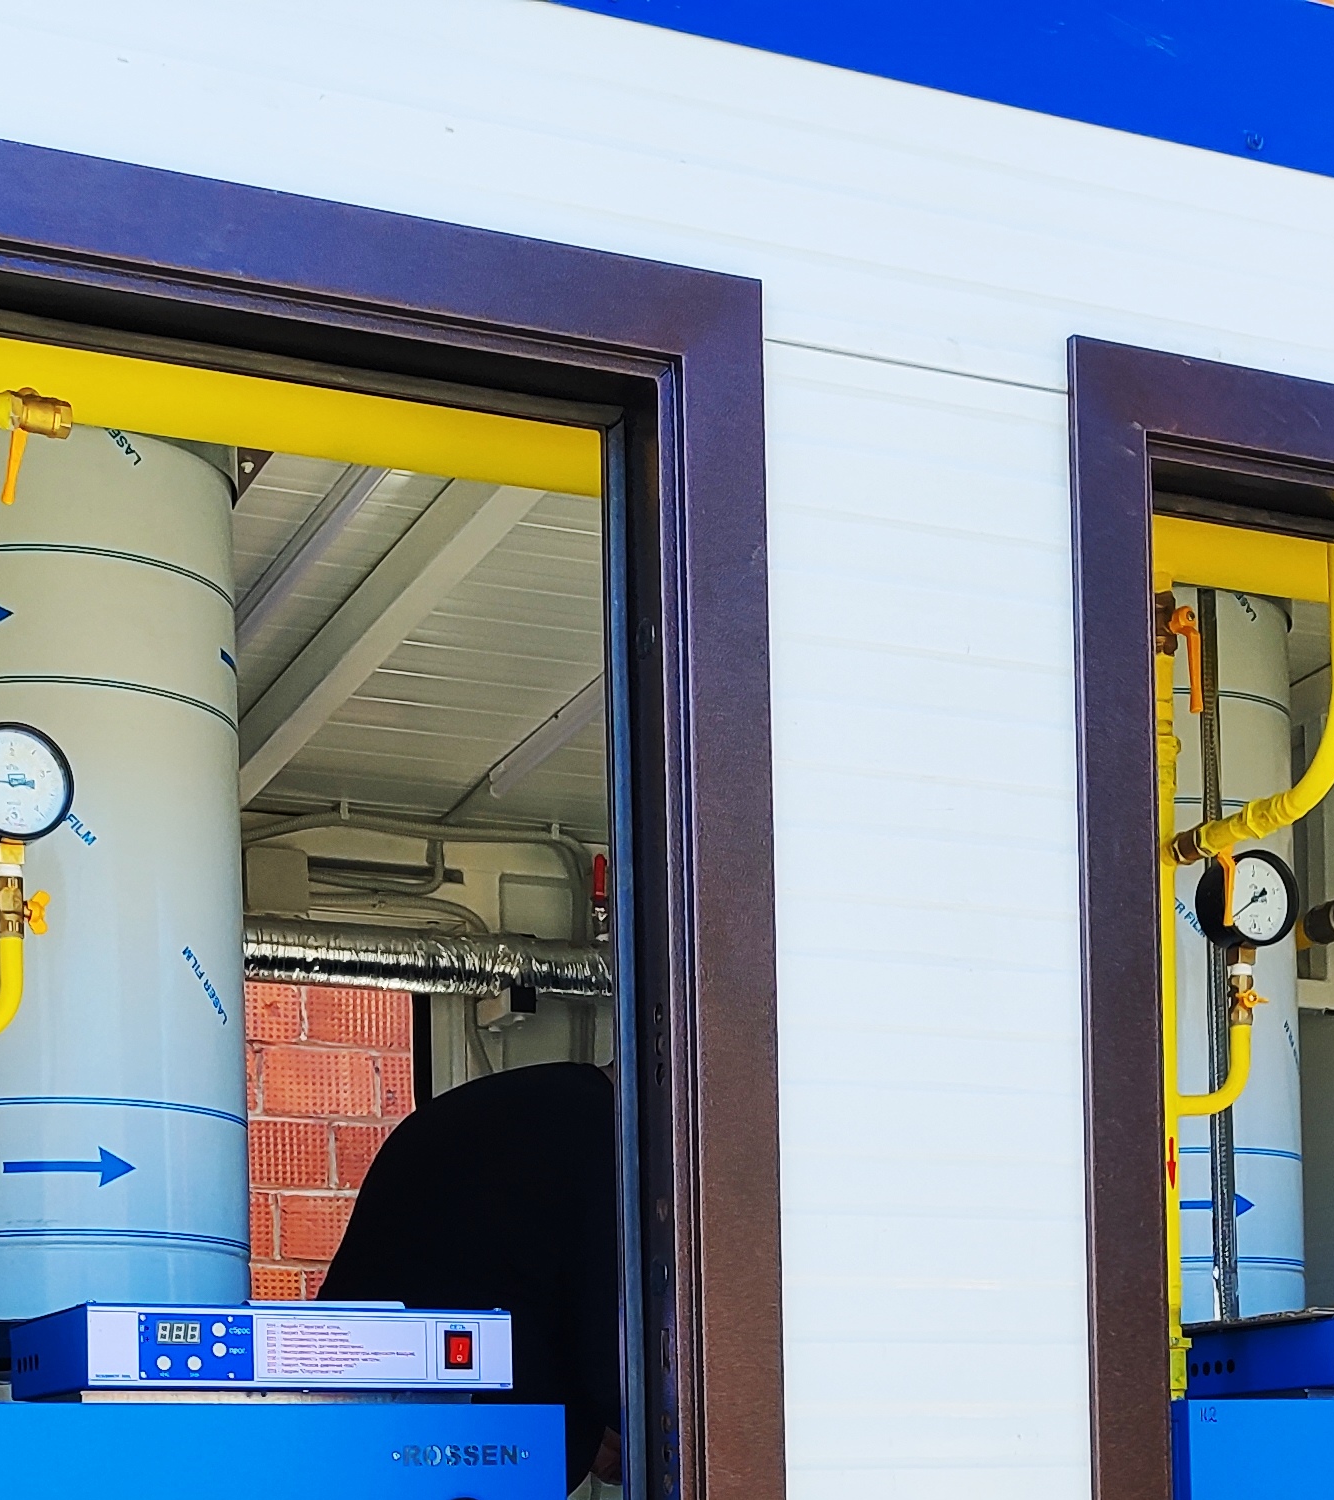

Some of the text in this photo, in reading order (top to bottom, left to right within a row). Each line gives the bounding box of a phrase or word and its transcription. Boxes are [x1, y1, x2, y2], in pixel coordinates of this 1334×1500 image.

[182, 946, 228, 1026] LASER FILM
[402, 1444, 519, 1467] ROSSEN
